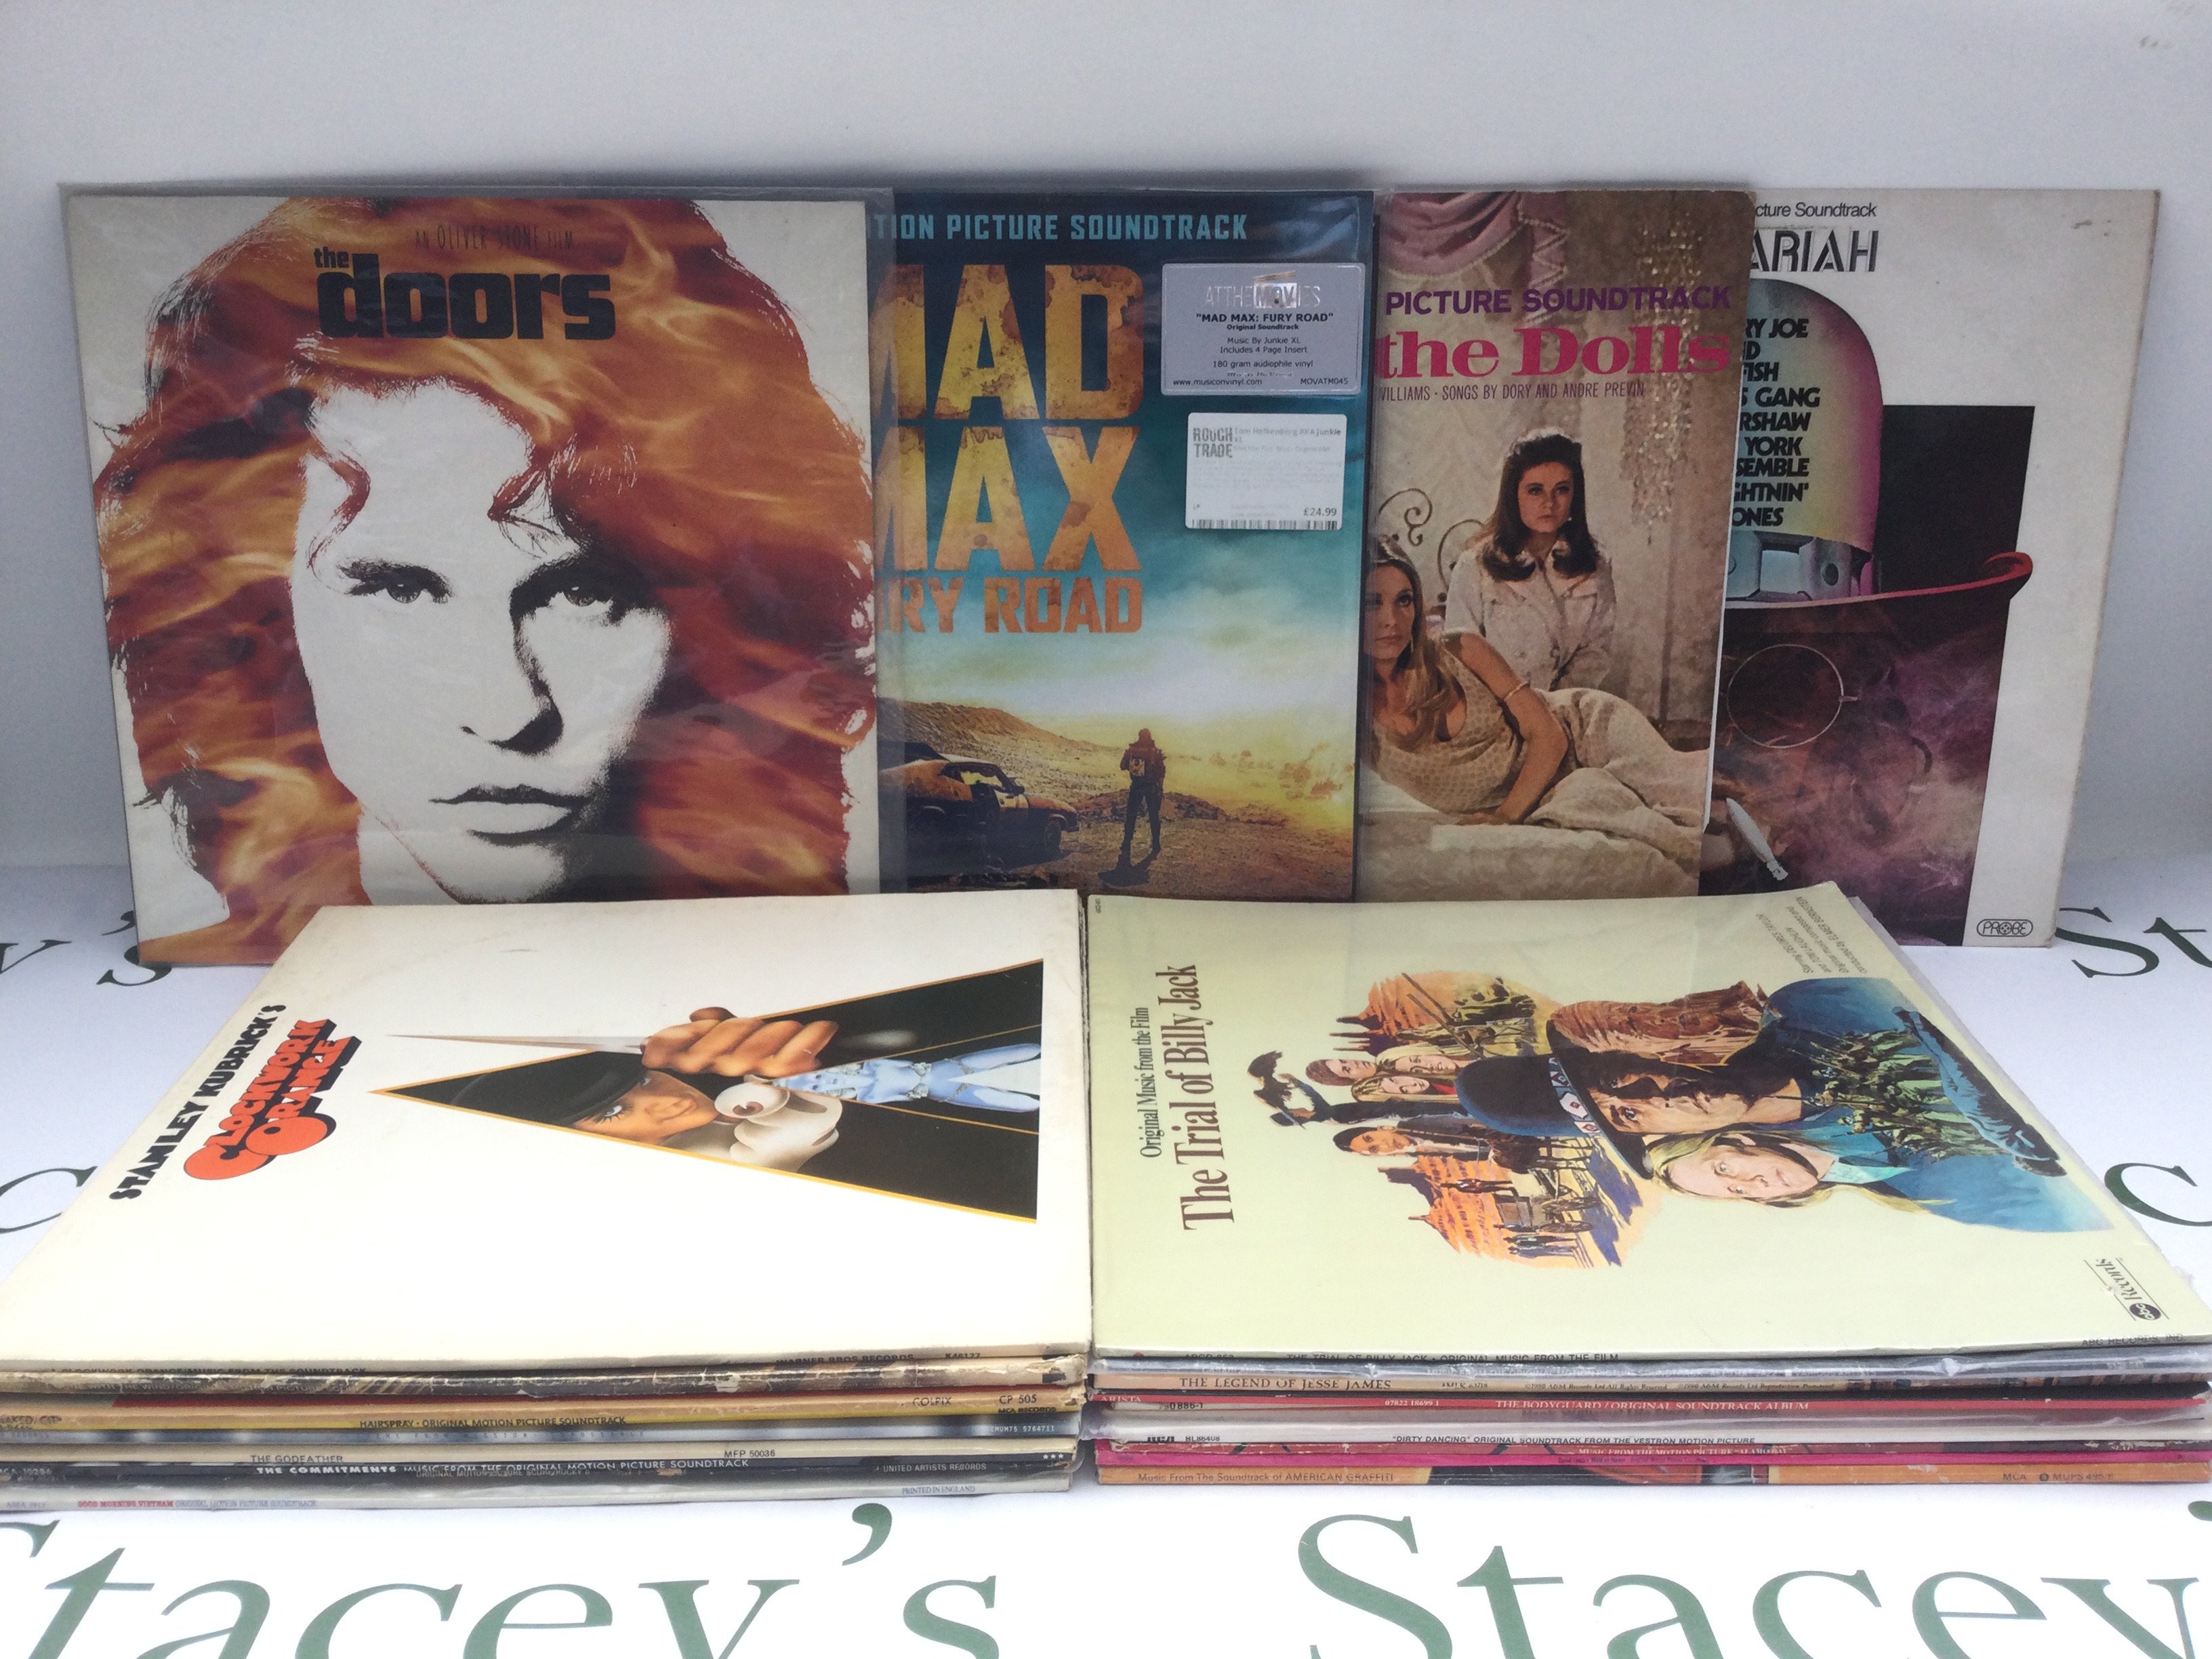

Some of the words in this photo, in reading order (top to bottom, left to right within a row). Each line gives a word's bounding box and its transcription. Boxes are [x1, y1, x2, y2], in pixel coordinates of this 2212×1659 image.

[1755, 203, 1791, 217] cture
[1795, 203, 1877, 217] Soundtrack
[947, 214, 1058, 240] PICTURE
[1071, 214, 1247, 241] SOUNDTRACK
[438, 225, 487, 250] OLIVER
[314, 246, 349, 268] the
[317, 253, 616, 340] doors
[1386, 289, 1511, 315] PICTURE
[1523, 285, 1732, 312] SOUNDTRACK
[1196, 313, 1227, 323] "MAD
[1231, 313, 1259, 323] MAX:
[1263, 313, 1292, 323] FURY
[1296, 313, 1334, 323] ROAD"
[1769, 319, 1809, 338] JOE
[1252, 337, 1262, 346] By
[1263, 346, 1282, 355] Page
[1374, 331, 1499, 380] the
[1511, 326, 1729, 377] Dolls
[1253, 360, 1292, 369] audiophile
[1295, 360, 1313, 369] vinyl
[1173, 378, 1262, 388] www.musiconvinyl.com
[1442, 384, 1480, 400] SONGS
[1483, 384, 1496, 398] BY
[1502, 384, 1532, 398] DORY
[1536, 384, 1557, 398] AND
[1563, 383, 1599, 398] ANDRE
[1604, 381, 1644, 397] PREVIN
[1755, 388, 1820, 407] GANG
[1740, 412, 1811, 432] RSHAW
[1193, 427, 1232, 443] ROUGH
[1194, 444, 1233, 458] TRADE
[1744, 437, 1803, 456] YORK
[1736, 458, 1810, 477] SEMBLE
[1303, 508, 1337, 516] £24.99
[1732, 508, 1784, 527] ONES
[984, 577, 1143, 634] ROAD
[1982, 921, 2028, 935] PROBE
[1155, 964, 1202, 1010] Jack
[1130, 1007, 1150, 1029] Film
[1132, 1031, 1151, 1046] the
[1160, 1012, 1214, 1065] Billy
[1134, 1046, 1154, 1069] from
[1135, 1071, 1158, 1106] Music
[1165, 1069, 1214, 1094] of
[109, 1101, 209, 1200] STANLEY
[192, 1004, 287, 1098] KUBRICK'S
[184, 1019, 337, 1180] CLOCKWORK
[245, 1036, 362, 1155] ORANGE
[1137, 1107, 1165, 1158] Original
[1169, 1101, 1225, 1165] Trial
[1180, 1168, 1235, 1231] The
[1180, 1378, 1207, 1387] THE
[1215, 1378, 1270, 1388] LEGEND
[1276, 1378, 1296, 1388] OF
[1303, 1378, 1339, 1389] JESSE
[1347, 1379, 1391, 1389] JAMES
[914, 1397, 952, 1407] COLPIX
[999, 1395, 1012, 1404] CP
[1019, 1394, 1037, 1404] 505
[1677, 1401, 1763, 1410] SOUNDTRACK
[1765, 1401, 1809, 1410] ALBUM
[359, 1420, 414, 1429] HAIRSPRAY
[422, 1419, 472, 1429] ORIGINAL
[474, 1419, 513, 1427] MOTION
[516, 1418, 556, 1427] PICTURE
[559, 1416, 626, 1425] SOUNDTRACK
[251, 1455, 270, 1464] THE
[274, 1455, 343, 1464] GODFATHER
[749, 1450, 775, 1458] 50036
[289, 1466, 397, 1475] COMMITMENTS
[567, 1462, 615, 1470] MOTION
[620, 1460, 665, 1469] PICTURE
[670, 1459, 749, 1469] SOUNDTRACK
[883, 1463, 912, 1472] UNITED
[915, 1462, 947, 1471] ARTISTS
[949, 1462, 987, 1471] RECORDS
[1139, 1473, 1166, 1481] Music
[1170, 1473, 1193, 1481] From
[1196, 1473, 1214, 1481] The
[1218, 1473, 1269, 1481] Soundtrack
[1273, 1473, 1282, 1481] of
[1285, 1473, 1343, 1481] AMERICAN
[1346, 1473, 1394, 1481] GRAFFITI
[902, 1486, 931, 1494] PRINTED
[941, 1486, 976, 1494] ENGLAND
